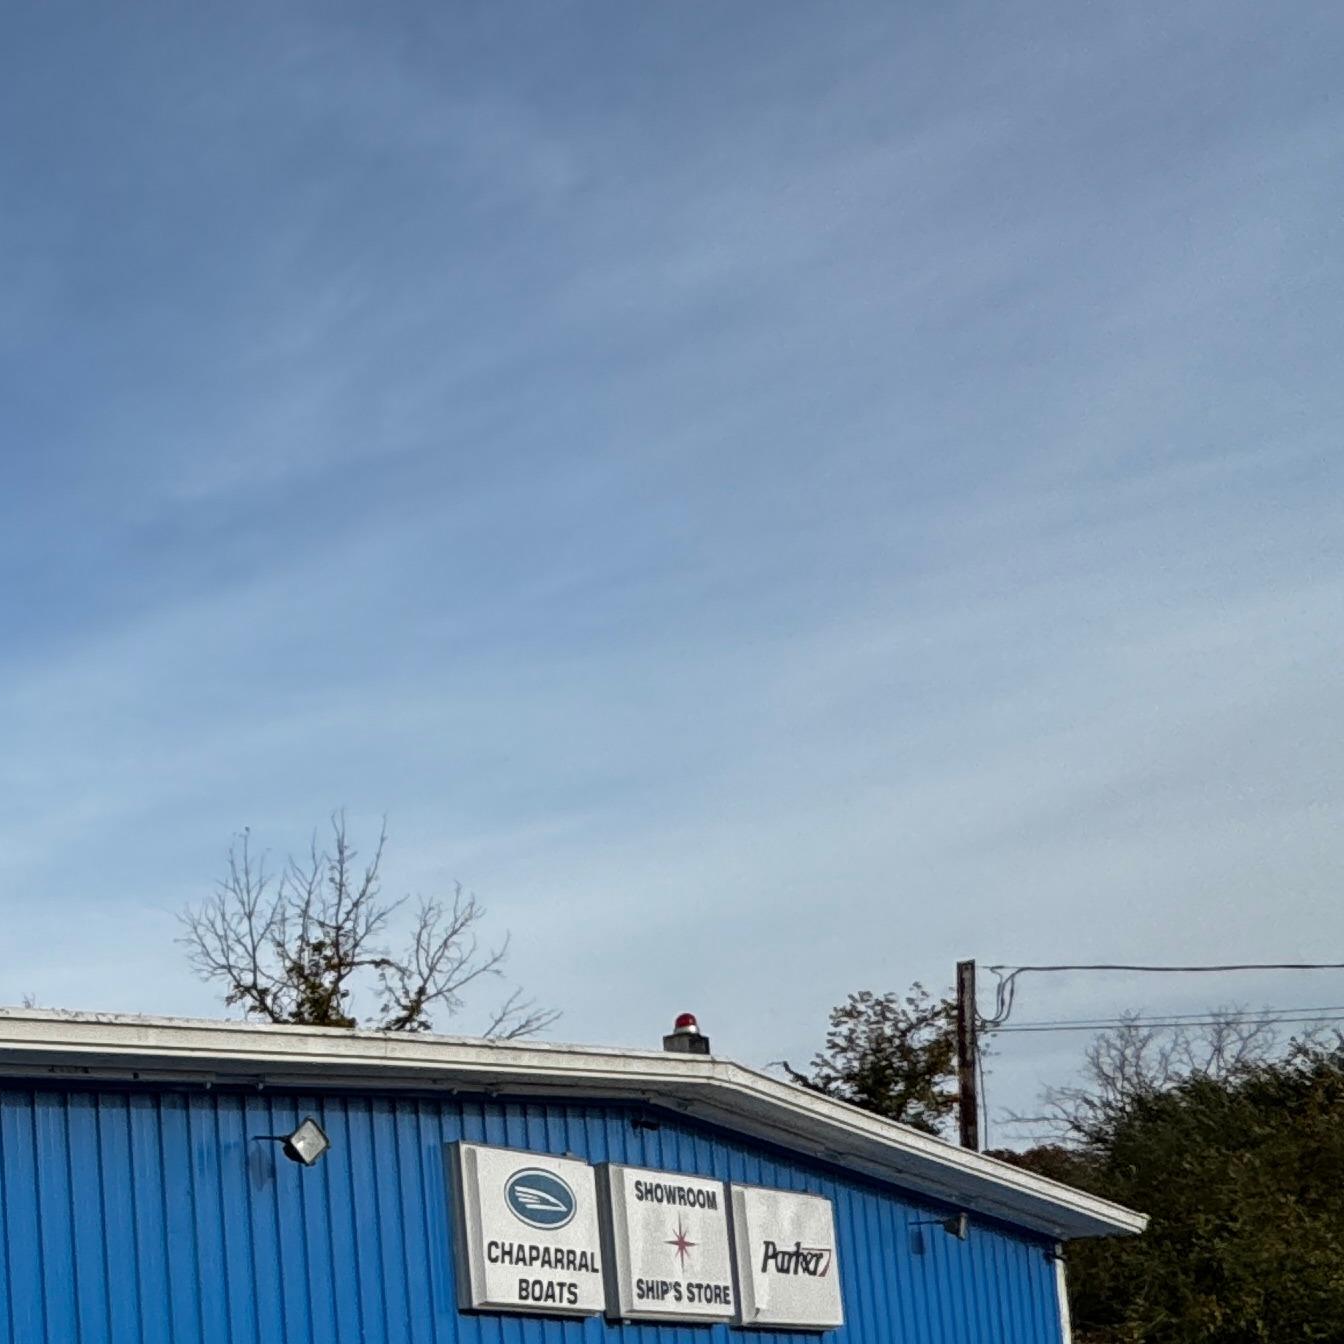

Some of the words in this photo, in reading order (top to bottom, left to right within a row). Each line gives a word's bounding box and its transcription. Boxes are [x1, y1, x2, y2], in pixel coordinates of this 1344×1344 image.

[634, 1179, 718, 1210] SHOWROOM
[487, 1240, 600, 1274] CHAPARRAL
[761, 1240, 832, 1277] Parker
[518, 1278, 578, 1305] BOATS
[636, 1277, 682, 1302] SHIP'S
[686, 1282, 731, 1306] STORE
